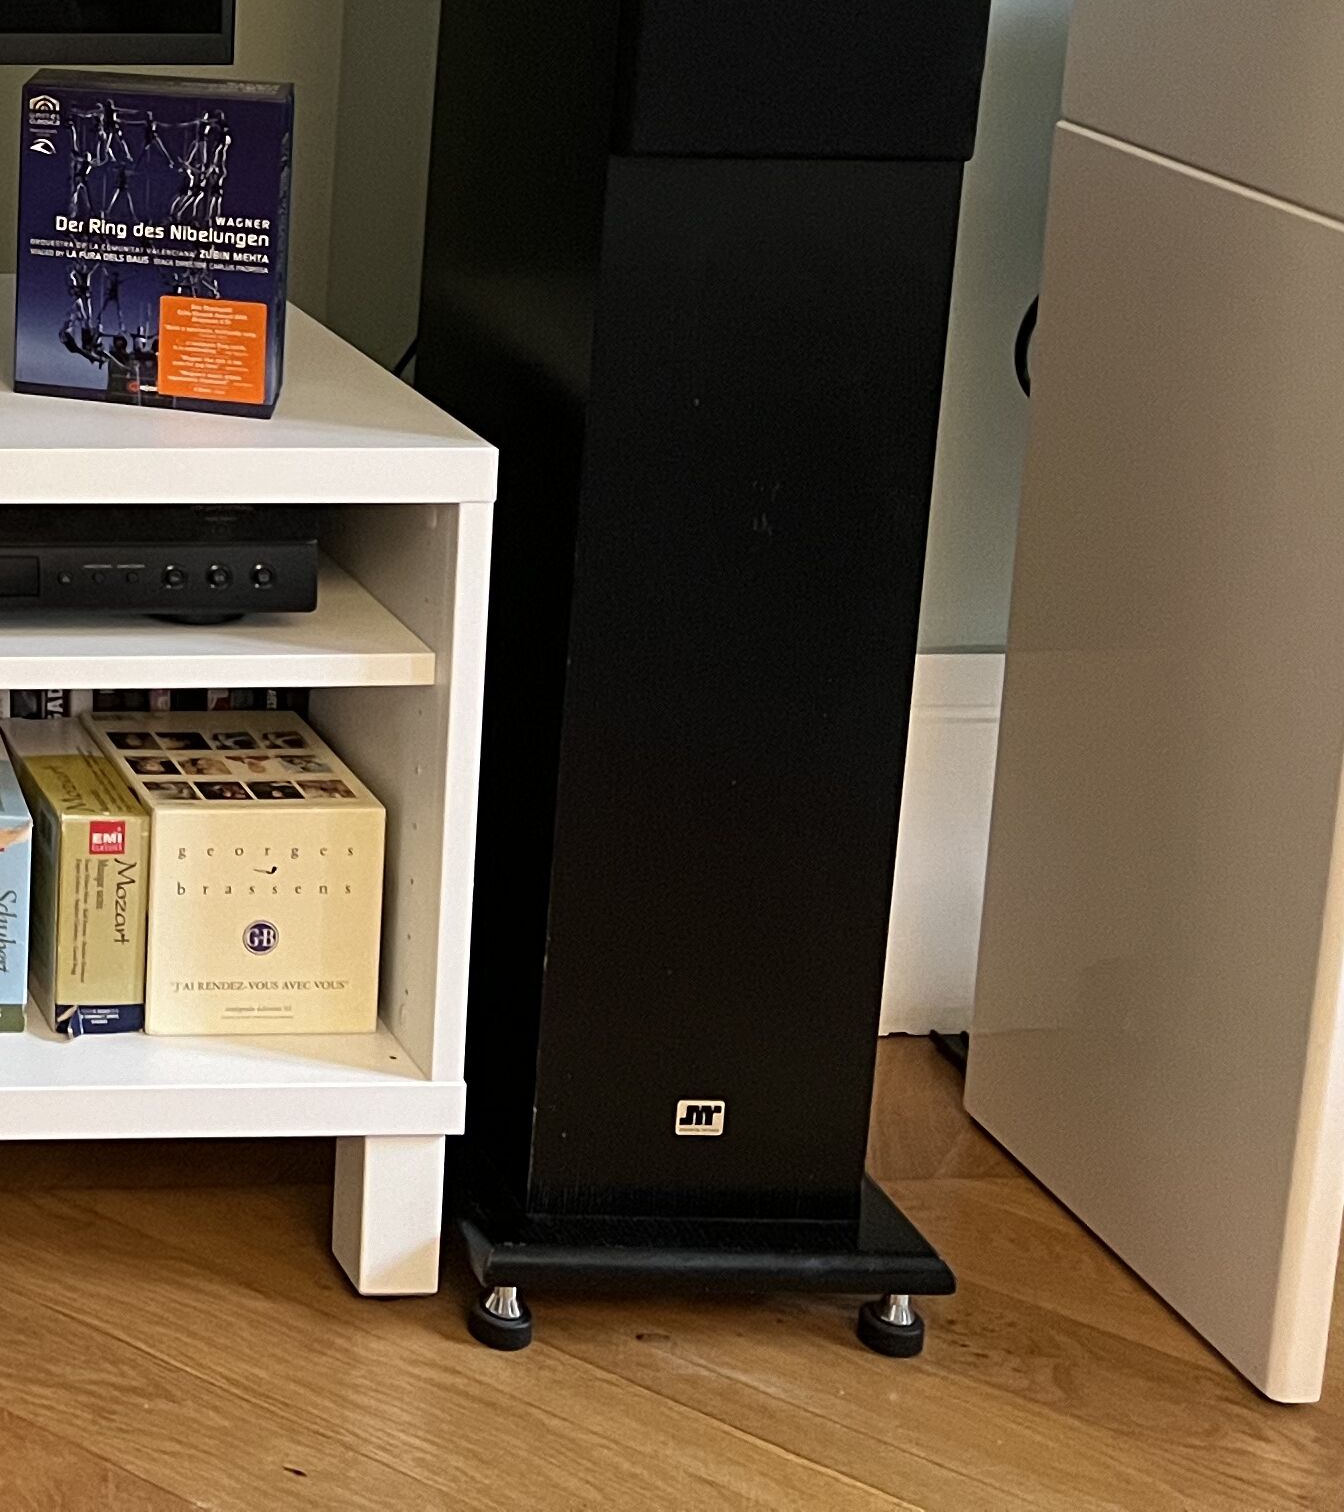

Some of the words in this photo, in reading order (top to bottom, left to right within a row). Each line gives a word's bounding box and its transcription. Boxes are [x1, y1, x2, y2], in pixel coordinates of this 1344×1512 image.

[215, 216, 271, 230] WAGNER
[55, 216, 84, 232] Der
[89, 218, 127, 239] Ring
[133, 222, 165, 238] des
[170, 224, 269, 248] Nibelungen
[233, 252, 269, 264] MEHTA
[92, 830, 123, 844] EMI
[177, 845, 354, 860] georges
[176, 881, 352, 896] brassens
[113, 858, 137, 945] Mozart
[198, 981, 279, 991] RENDEZ-VOUS
[282, 981, 311, 991] AVEC
